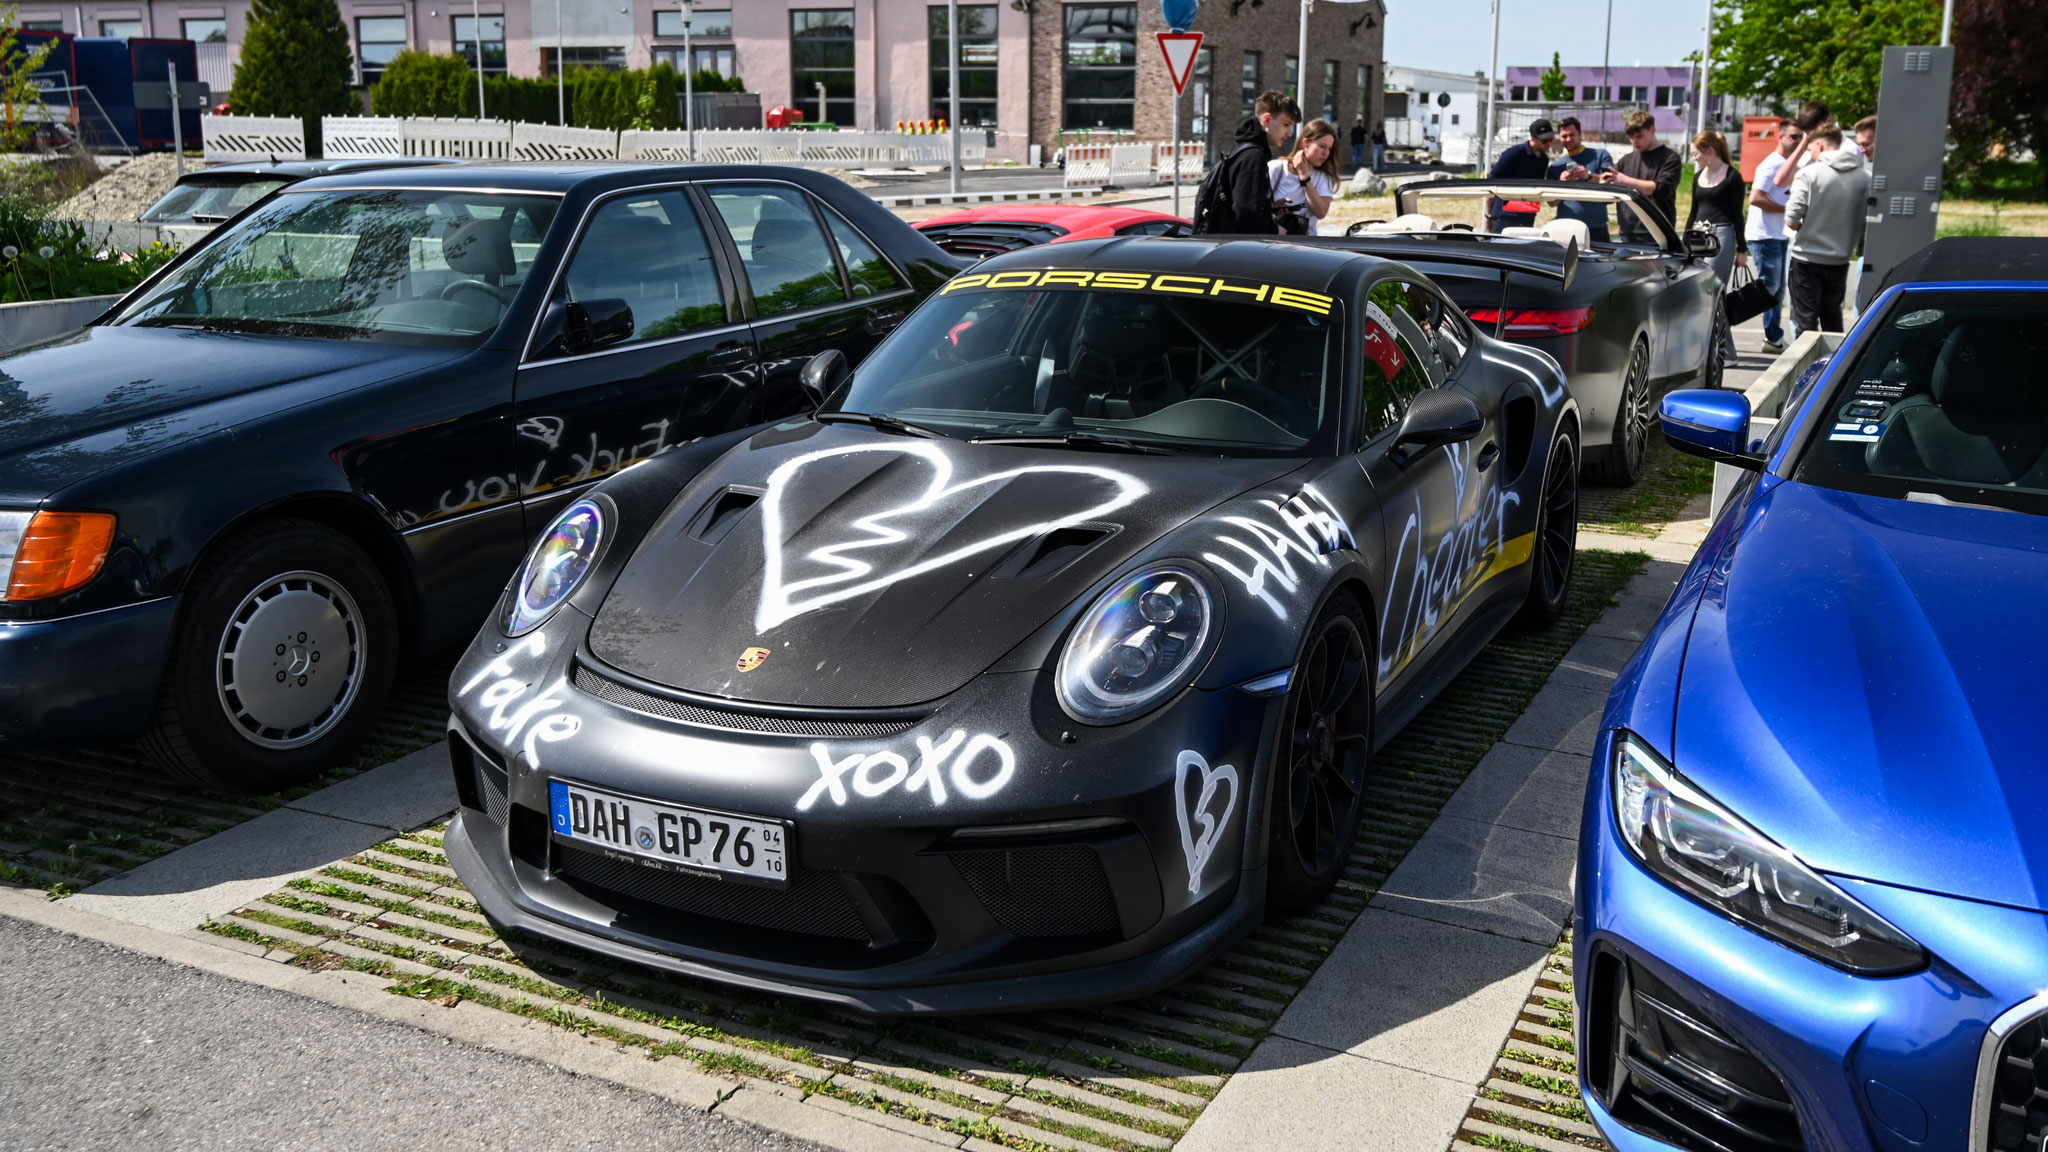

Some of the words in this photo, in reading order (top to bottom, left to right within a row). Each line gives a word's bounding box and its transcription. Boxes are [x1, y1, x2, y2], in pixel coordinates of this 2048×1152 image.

[939, 269, 1334, 316] PORSCHE
[1378, 475, 1521, 676] Cheater
[457, 631, 583, 770] Fake
[557, 814, 566, 827] D
[570, 792, 632, 846] DAH
[658, 812, 703, 858] GP
[709, 821, 756, 868] 76
[763, 829, 781, 843] 04
[766, 859, 783, 873] 10
